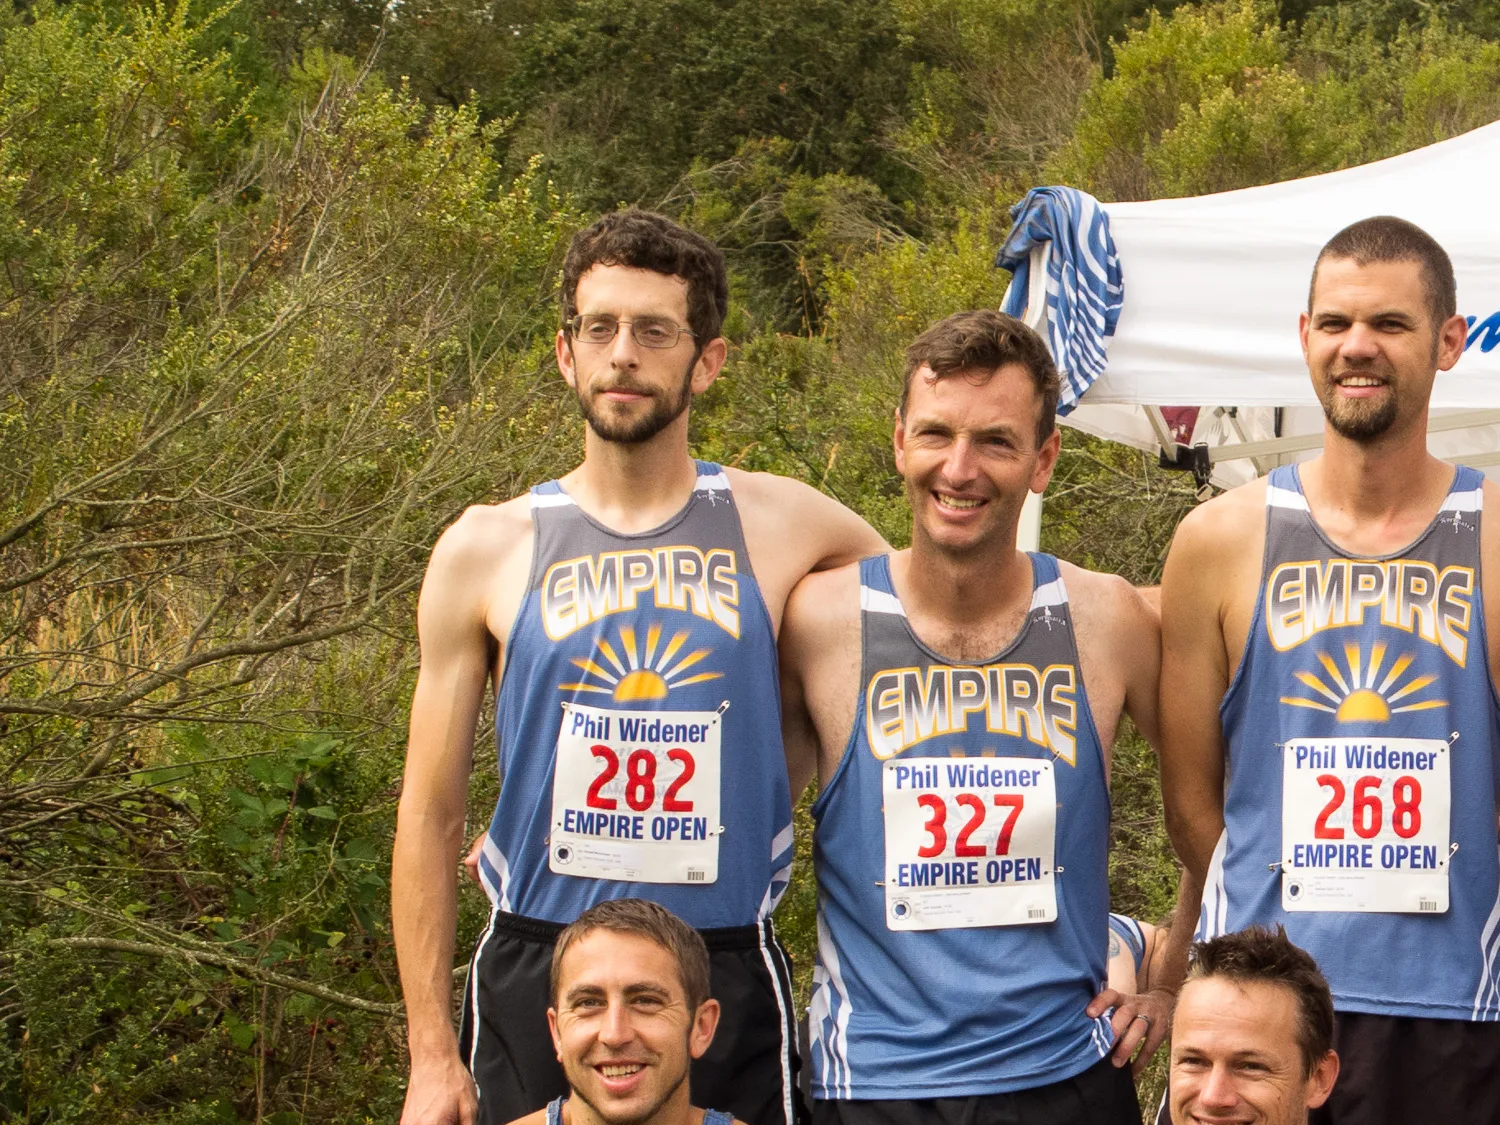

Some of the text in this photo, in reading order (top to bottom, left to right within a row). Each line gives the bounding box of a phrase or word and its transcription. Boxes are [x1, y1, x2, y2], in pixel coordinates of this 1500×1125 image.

[542, 546, 740, 640] EMPIRE
[1266, 559, 1475, 668] EMPIRE
[571, 712, 708, 744] Phil Widener
[867, 663, 1077, 767] EMPIRE
[587, 744, 694, 812] 282
[895, 764, 1040, 790] Phil Widener
[1296, 745, 1436, 770] Phil Widener
[563, 808, 707, 840] EMPIRE OPEN
[917, 793, 1024, 858] 327
[1314, 774, 1422, 839] 268
[898, 857, 1040, 886] EMPIRE OPEN
[1293, 844, 1436, 870] EMPIRE OPEN
